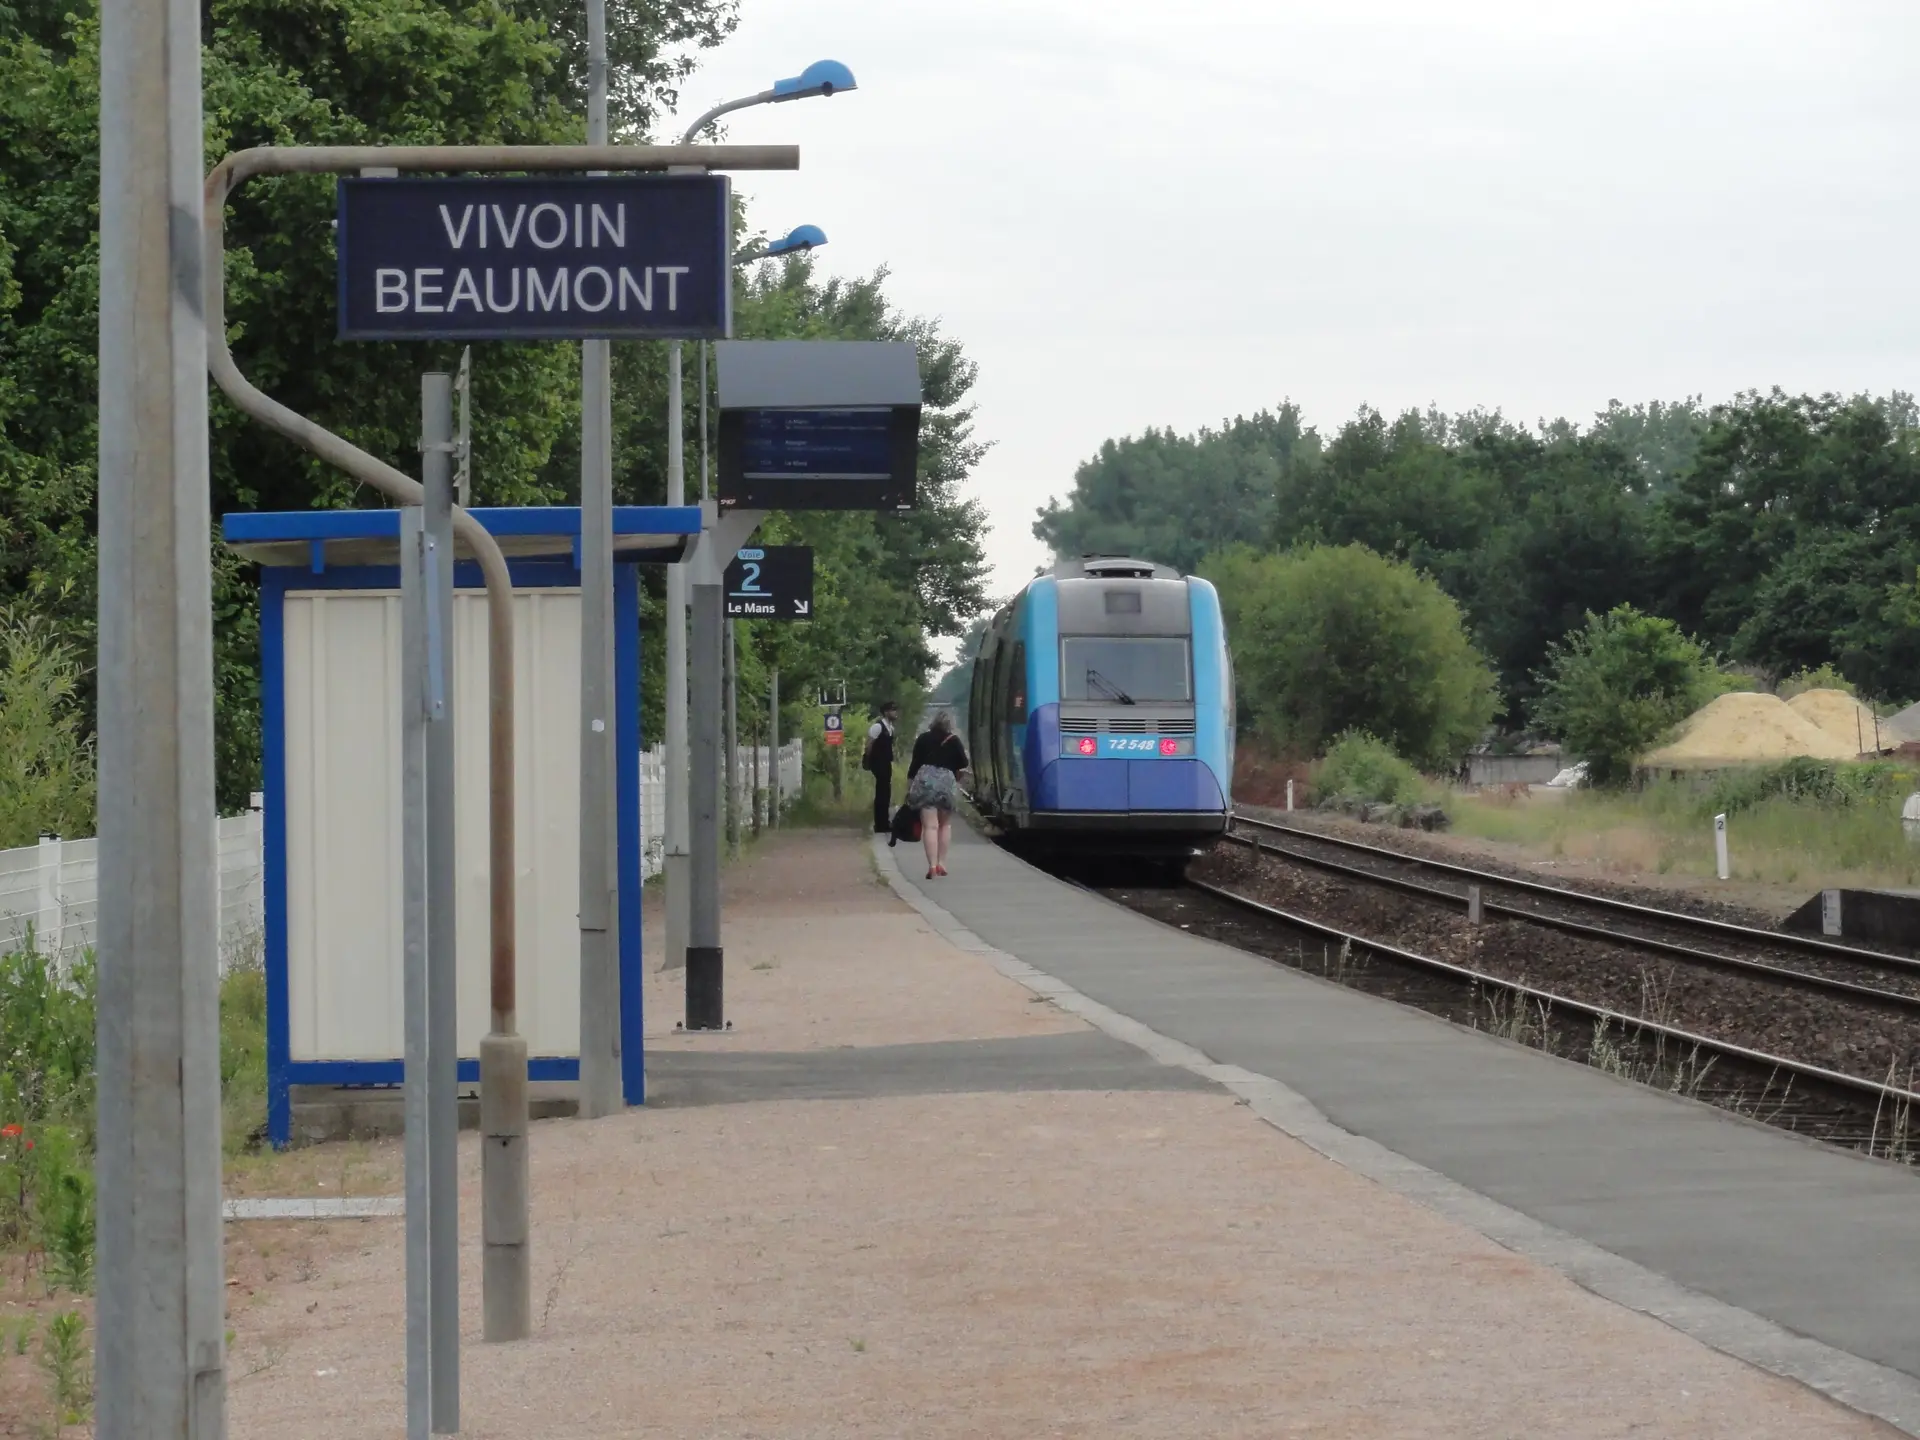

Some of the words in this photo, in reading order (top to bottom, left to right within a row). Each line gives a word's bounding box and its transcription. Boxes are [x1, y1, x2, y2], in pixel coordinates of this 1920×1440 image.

[439, 203, 626, 249] VIVOIN
[375, 265, 690, 314] BEAUMONT
[741, 550, 762, 559] Voie
[741, 562, 761, 591] 2
[728, 602, 742, 613] Le
[744, 602, 776, 613] Mans
[1717, 820, 1725, 830] 2
